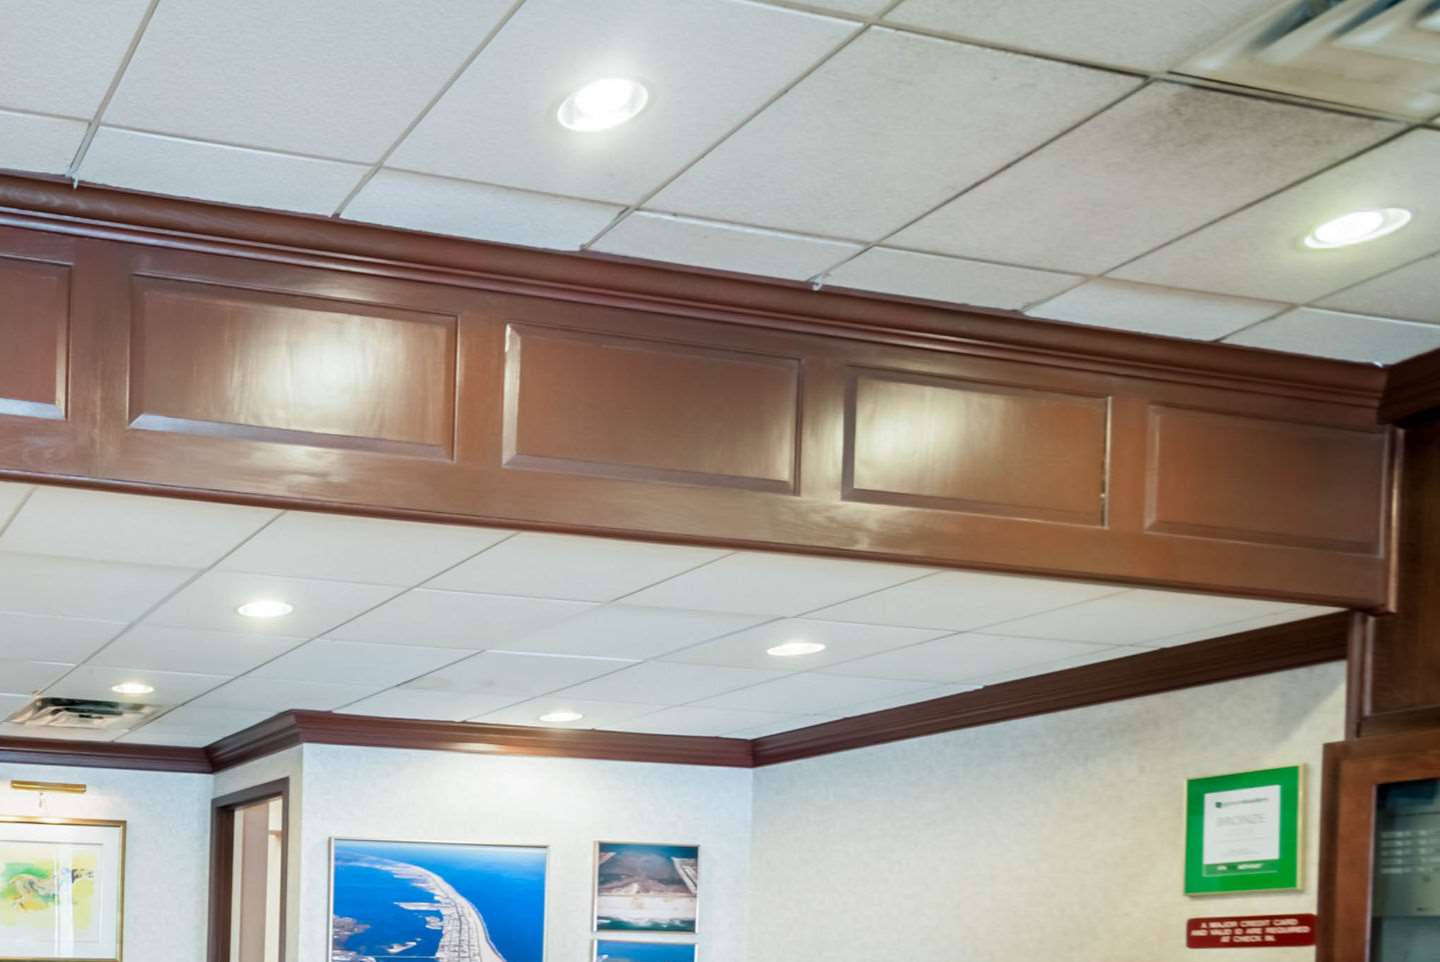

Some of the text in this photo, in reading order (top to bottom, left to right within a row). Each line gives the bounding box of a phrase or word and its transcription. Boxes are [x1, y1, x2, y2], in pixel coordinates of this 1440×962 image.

[1240, 919, 1271, 927] CREDIT
[1272, 918, 1299, 926] CARD
[1210, 928, 1233, 936] VALID
[1264, 925, 1311, 934] REQUIRED
[1232, 935, 1263, 943] CHECK
